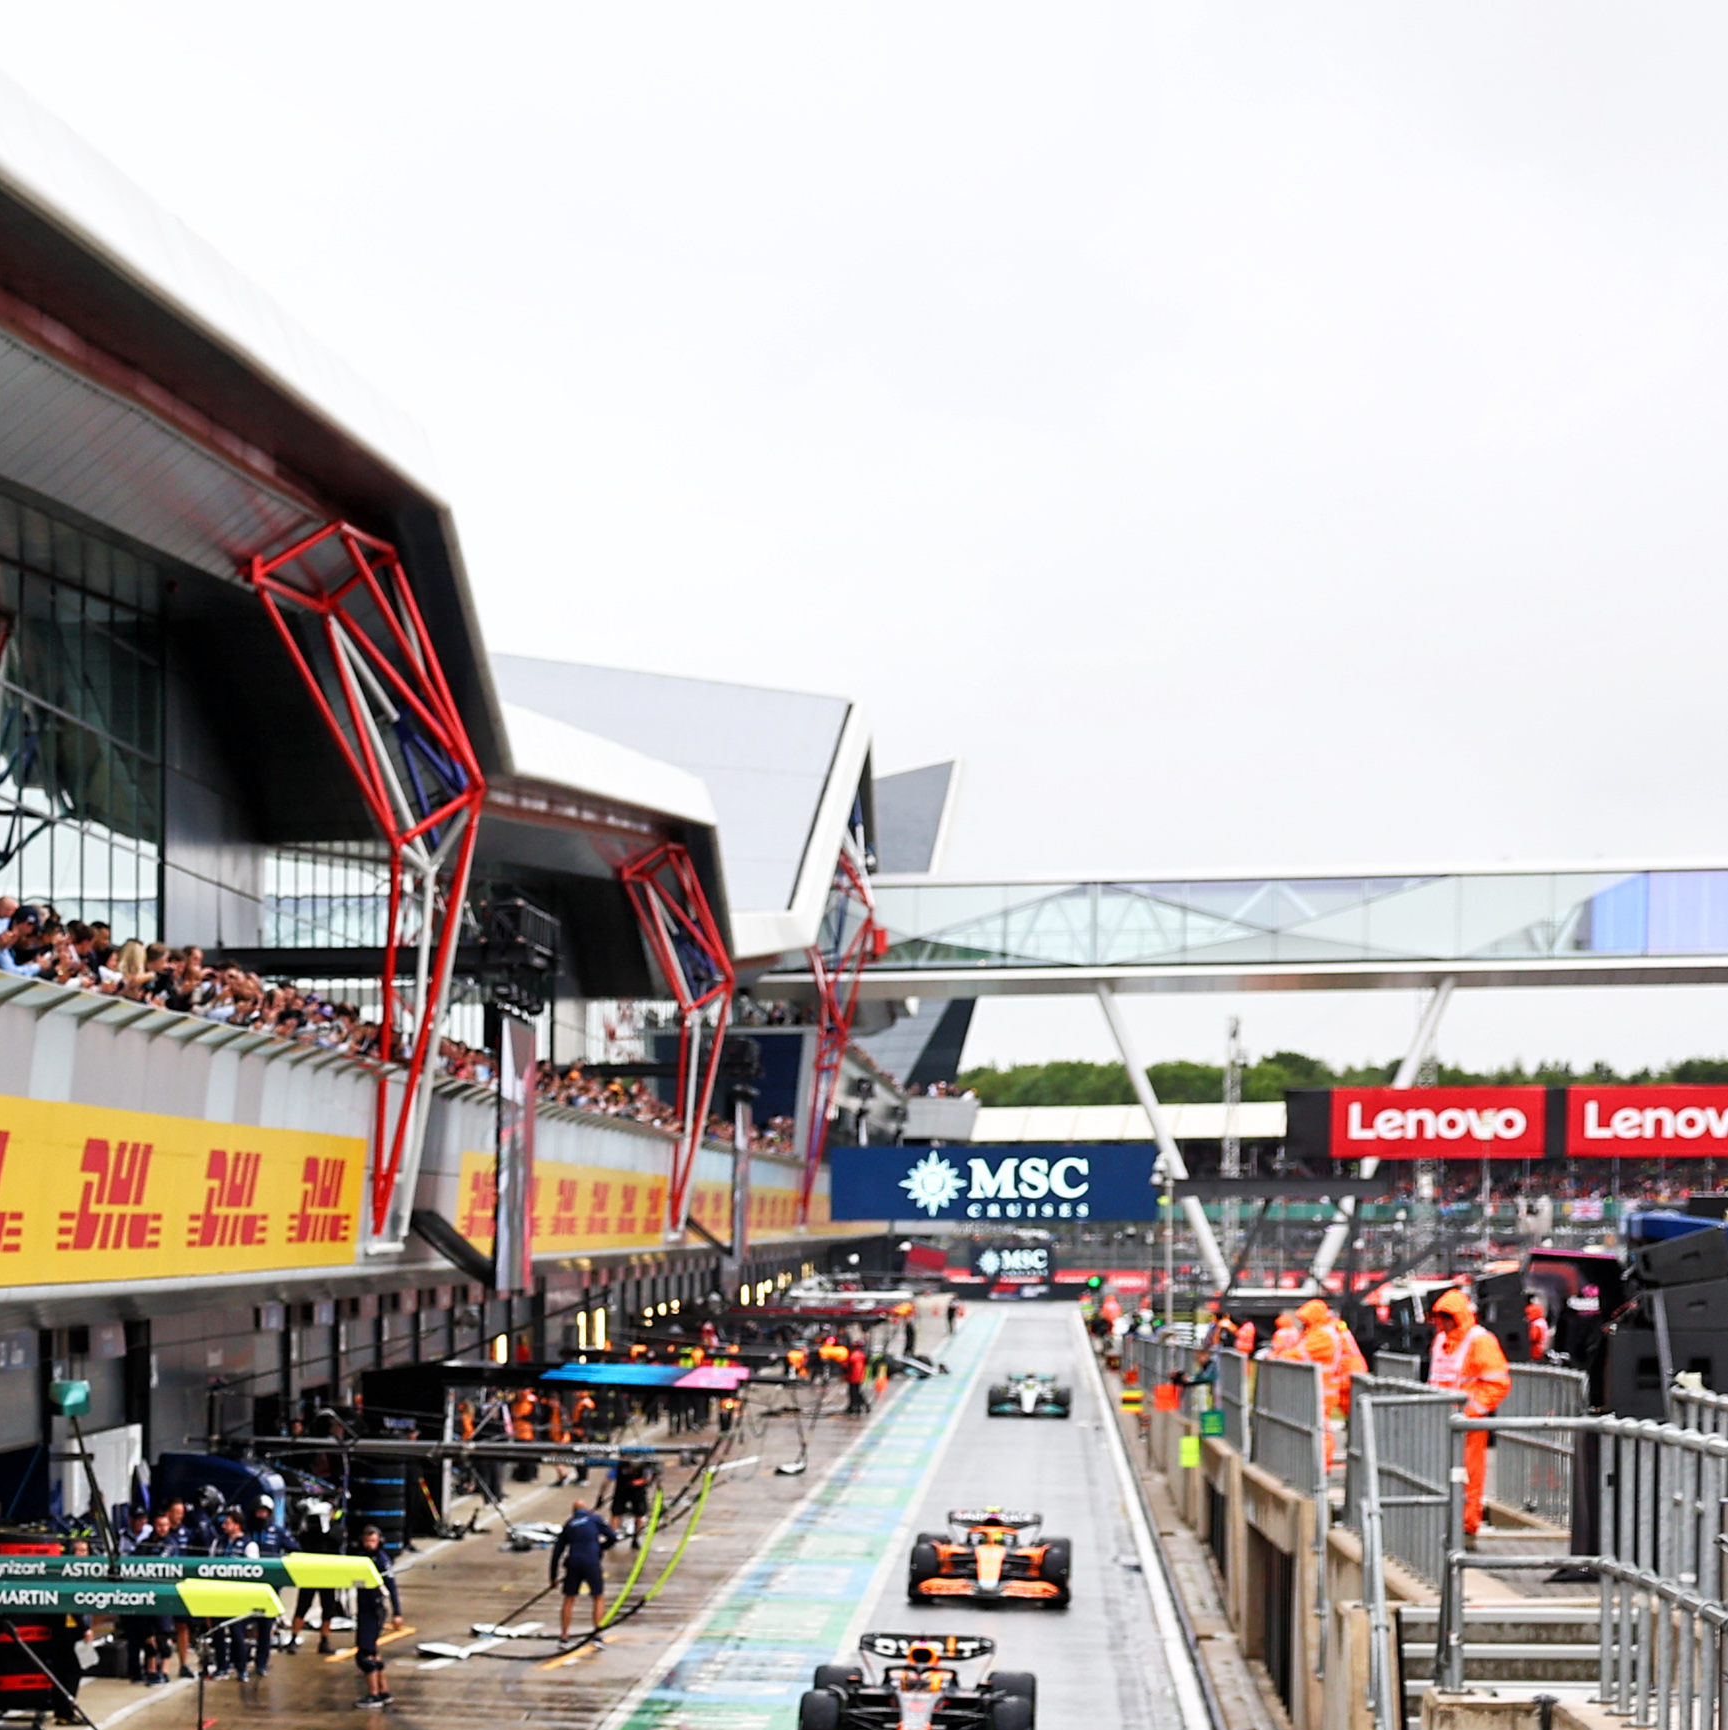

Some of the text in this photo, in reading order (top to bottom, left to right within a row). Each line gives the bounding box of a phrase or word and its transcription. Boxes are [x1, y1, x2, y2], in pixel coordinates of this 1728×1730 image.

[1347, 1101, 1527, 1141] Lenovo
[72, 1138, 154, 1250] DHL
[199, 1149, 261, 1247] DHL
[966, 1157, 1091, 1200] MSC
[291, 1157, 347, 1244] DHL
[966, 1201, 1091, 1219] CRUISES
[119, 1562, 184, 1579] MARTIN
[197, 1564, 264, 1579] aramco
[74, 1588, 156, 1610] cognizant
